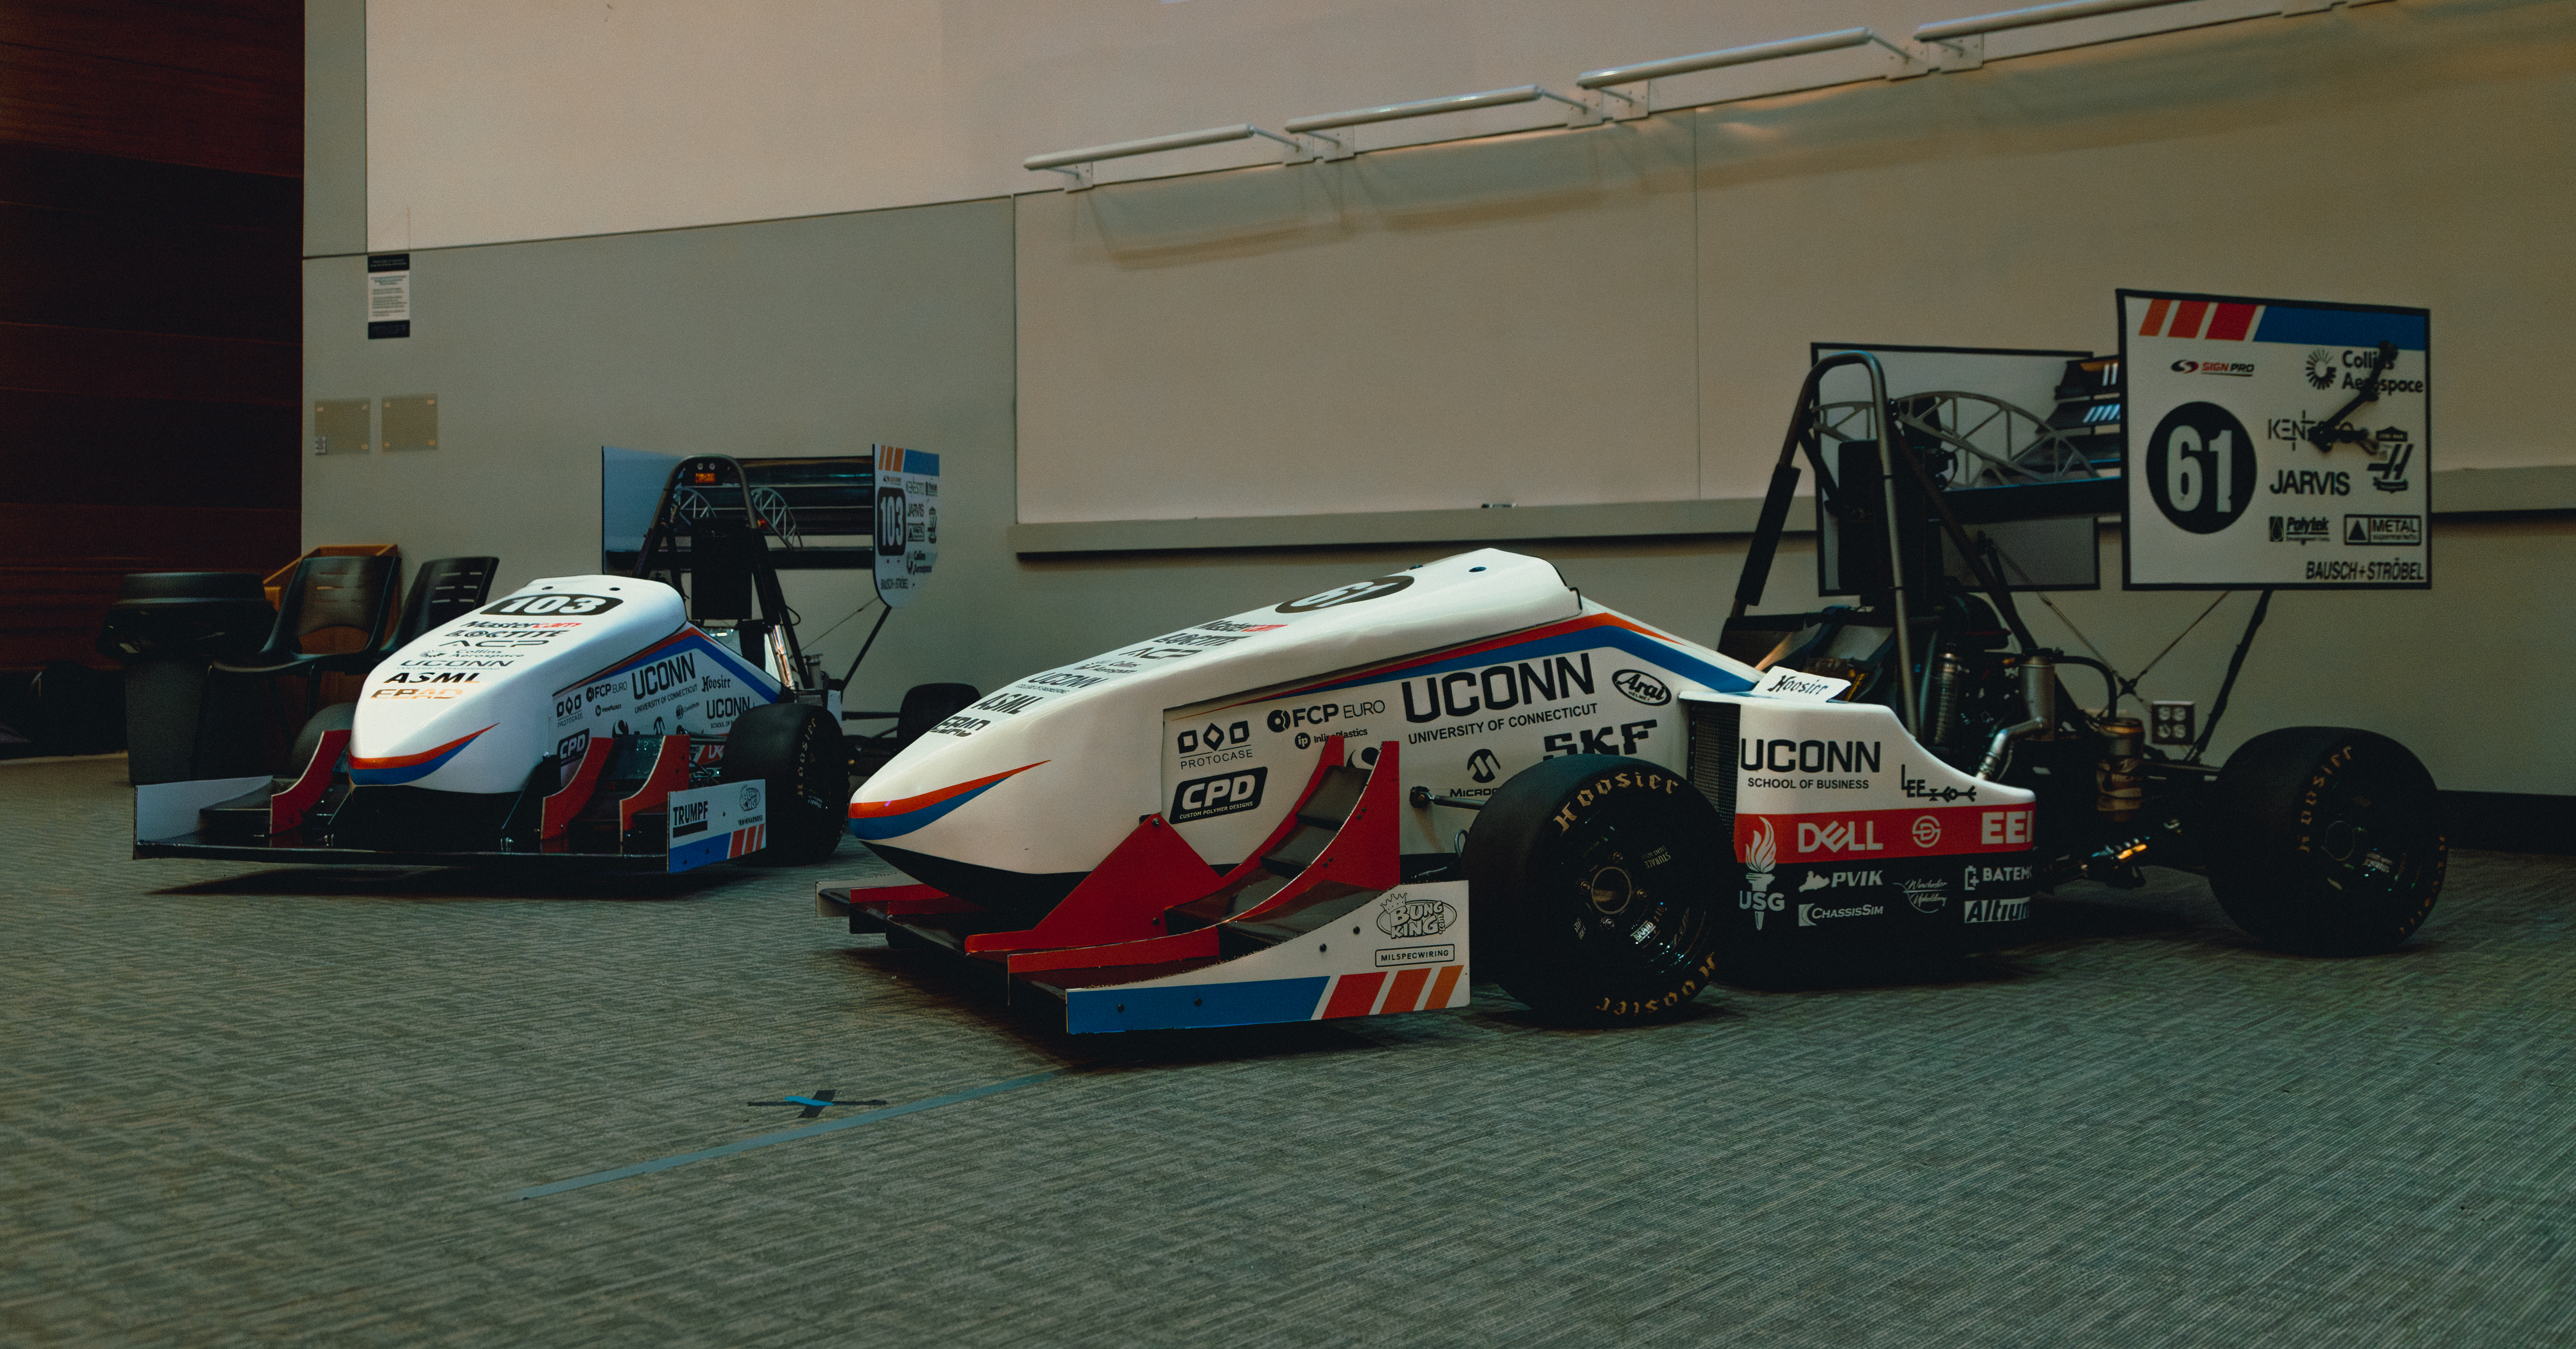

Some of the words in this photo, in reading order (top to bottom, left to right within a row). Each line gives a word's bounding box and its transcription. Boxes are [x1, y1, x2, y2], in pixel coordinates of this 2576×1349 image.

[2203, 362, 2229, 371] SIGN
[2230, 363, 2254, 372] PRO
[2342, 350, 2394, 369] Collis
[2342, 372, 2423, 395] Aespace
[2167, 425, 2233, 513] 61
[2270, 470, 2351, 496] JARVIS
[880, 495, 903, 546] 103
[2287, 517, 2329, 533] Polytek
[2373, 519, 2416, 533] METAL
[499, 596, 606, 614] 103
[1290, 581, 1399, 607] 61
[443, 630, 570, 638] LOCTITE
[382, 672, 481, 683] ASML
[631, 652, 696, 700] UCONN
[1028, 672, 1110, 689] UCONN
[1615, 673, 1665, 700] Arai
[594, 683, 611, 699] FCP
[634, 698, 660, 714] UNIVERSITY
[667, 684, 698, 701] CONNECTICUT
[1401, 653, 1595, 723] UCONN
[706, 696, 750, 719] UCONN
[970, 693, 1044, 714] ASML
[1292, 703, 1339, 727] FCP
[1343, 700, 1386, 719] EURO
[558, 713, 583, 728] PROTOCASE
[1409, 722, 1484, 744] UNIVERSITY
[1488, 718, 1505, 731] OF
[1508, 703, 1598, 727] CONNECTICUT
[560, 733, 586, 759] CPD
[1314, 728, 1368, 743] Inlilastics
[1543, 719, 1657, 762] SKF
[1180, 749, 1253, 770] PROTOCASE
[1741, 738, 1881, 773] UCONN
[1748, 778, 1796, 789] SCHOOL
[1799, 779, 1814, 789] OF
[1817, 780, 1869, 789] BUSINESS
[1901, 764, 1926, 797] LEE
[1182, 774, 1256, 811] CPD
[673, 801, 708, 825] TRUMPF
[1179, 811, 1202, 819] CUSTOM
[1203, 806, 1228, 815] POLYMER
[1229, 801, 1253, 810] DESIGNS
[1798, 820, 1884, 853] DELL
[1831, 870, 1883, 888] PVIK
[1739, 890, 1785, 911] USG
[1390, 900, 1444, 927] BUNG
[1391, 914, 1440, 939] KING
[1381, 949, 1449, 962] MILSPECWIRING
